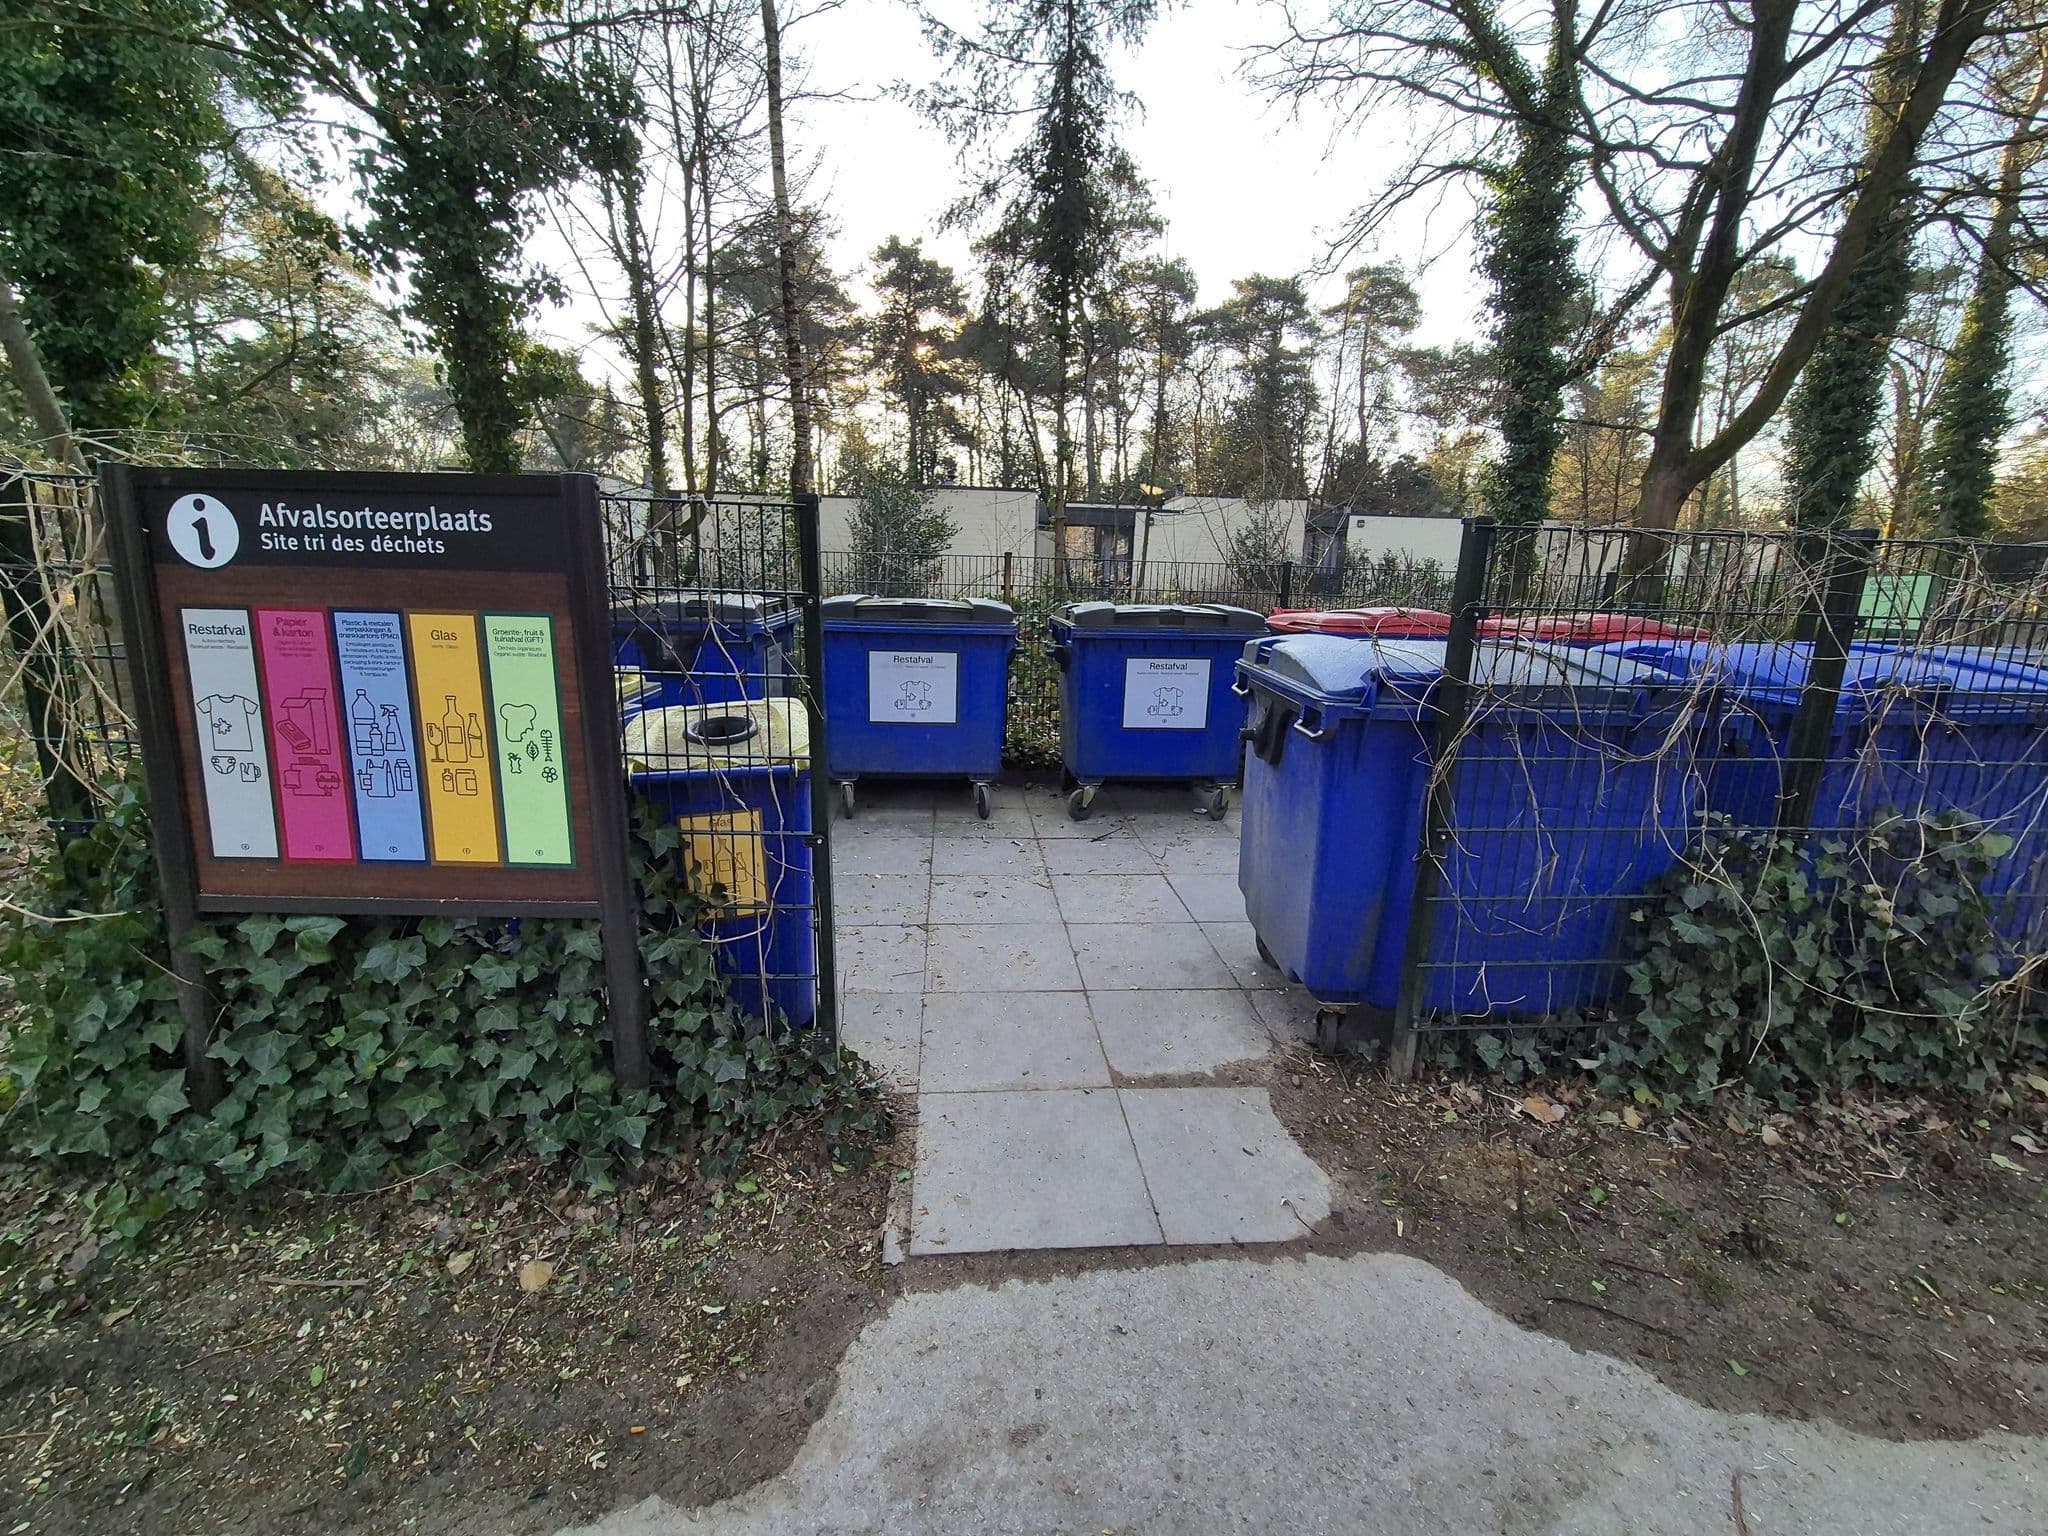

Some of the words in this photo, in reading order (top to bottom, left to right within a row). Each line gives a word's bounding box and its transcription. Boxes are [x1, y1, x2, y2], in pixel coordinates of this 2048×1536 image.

[259, 502, 493, 536] Afvalsorteerplaats
[260, 532, 299, 550] Site
[304, 534, 326, 552] tri
[332, 535, 365, 552] des
[371, 535, 446, 555] déchets
[276, 616, 308, 628] Papier
[341, 619, 363, 627] Plastic
[188, 623, 246, 637] Restafval
[272, 627, 280, 637] &
[281, 628, 314, 638] karton
[524, 629, 539, 637] fruit
[539, 629, 545, 637] &
[431, 630, 458, 642] Glas
[494, 635, 524, 643] tuinafval
[524, 636, 544, 644] (GFT)
[893, 655, 934, 664] Restafval
[1149, 662, 1188, 671] Restafval
